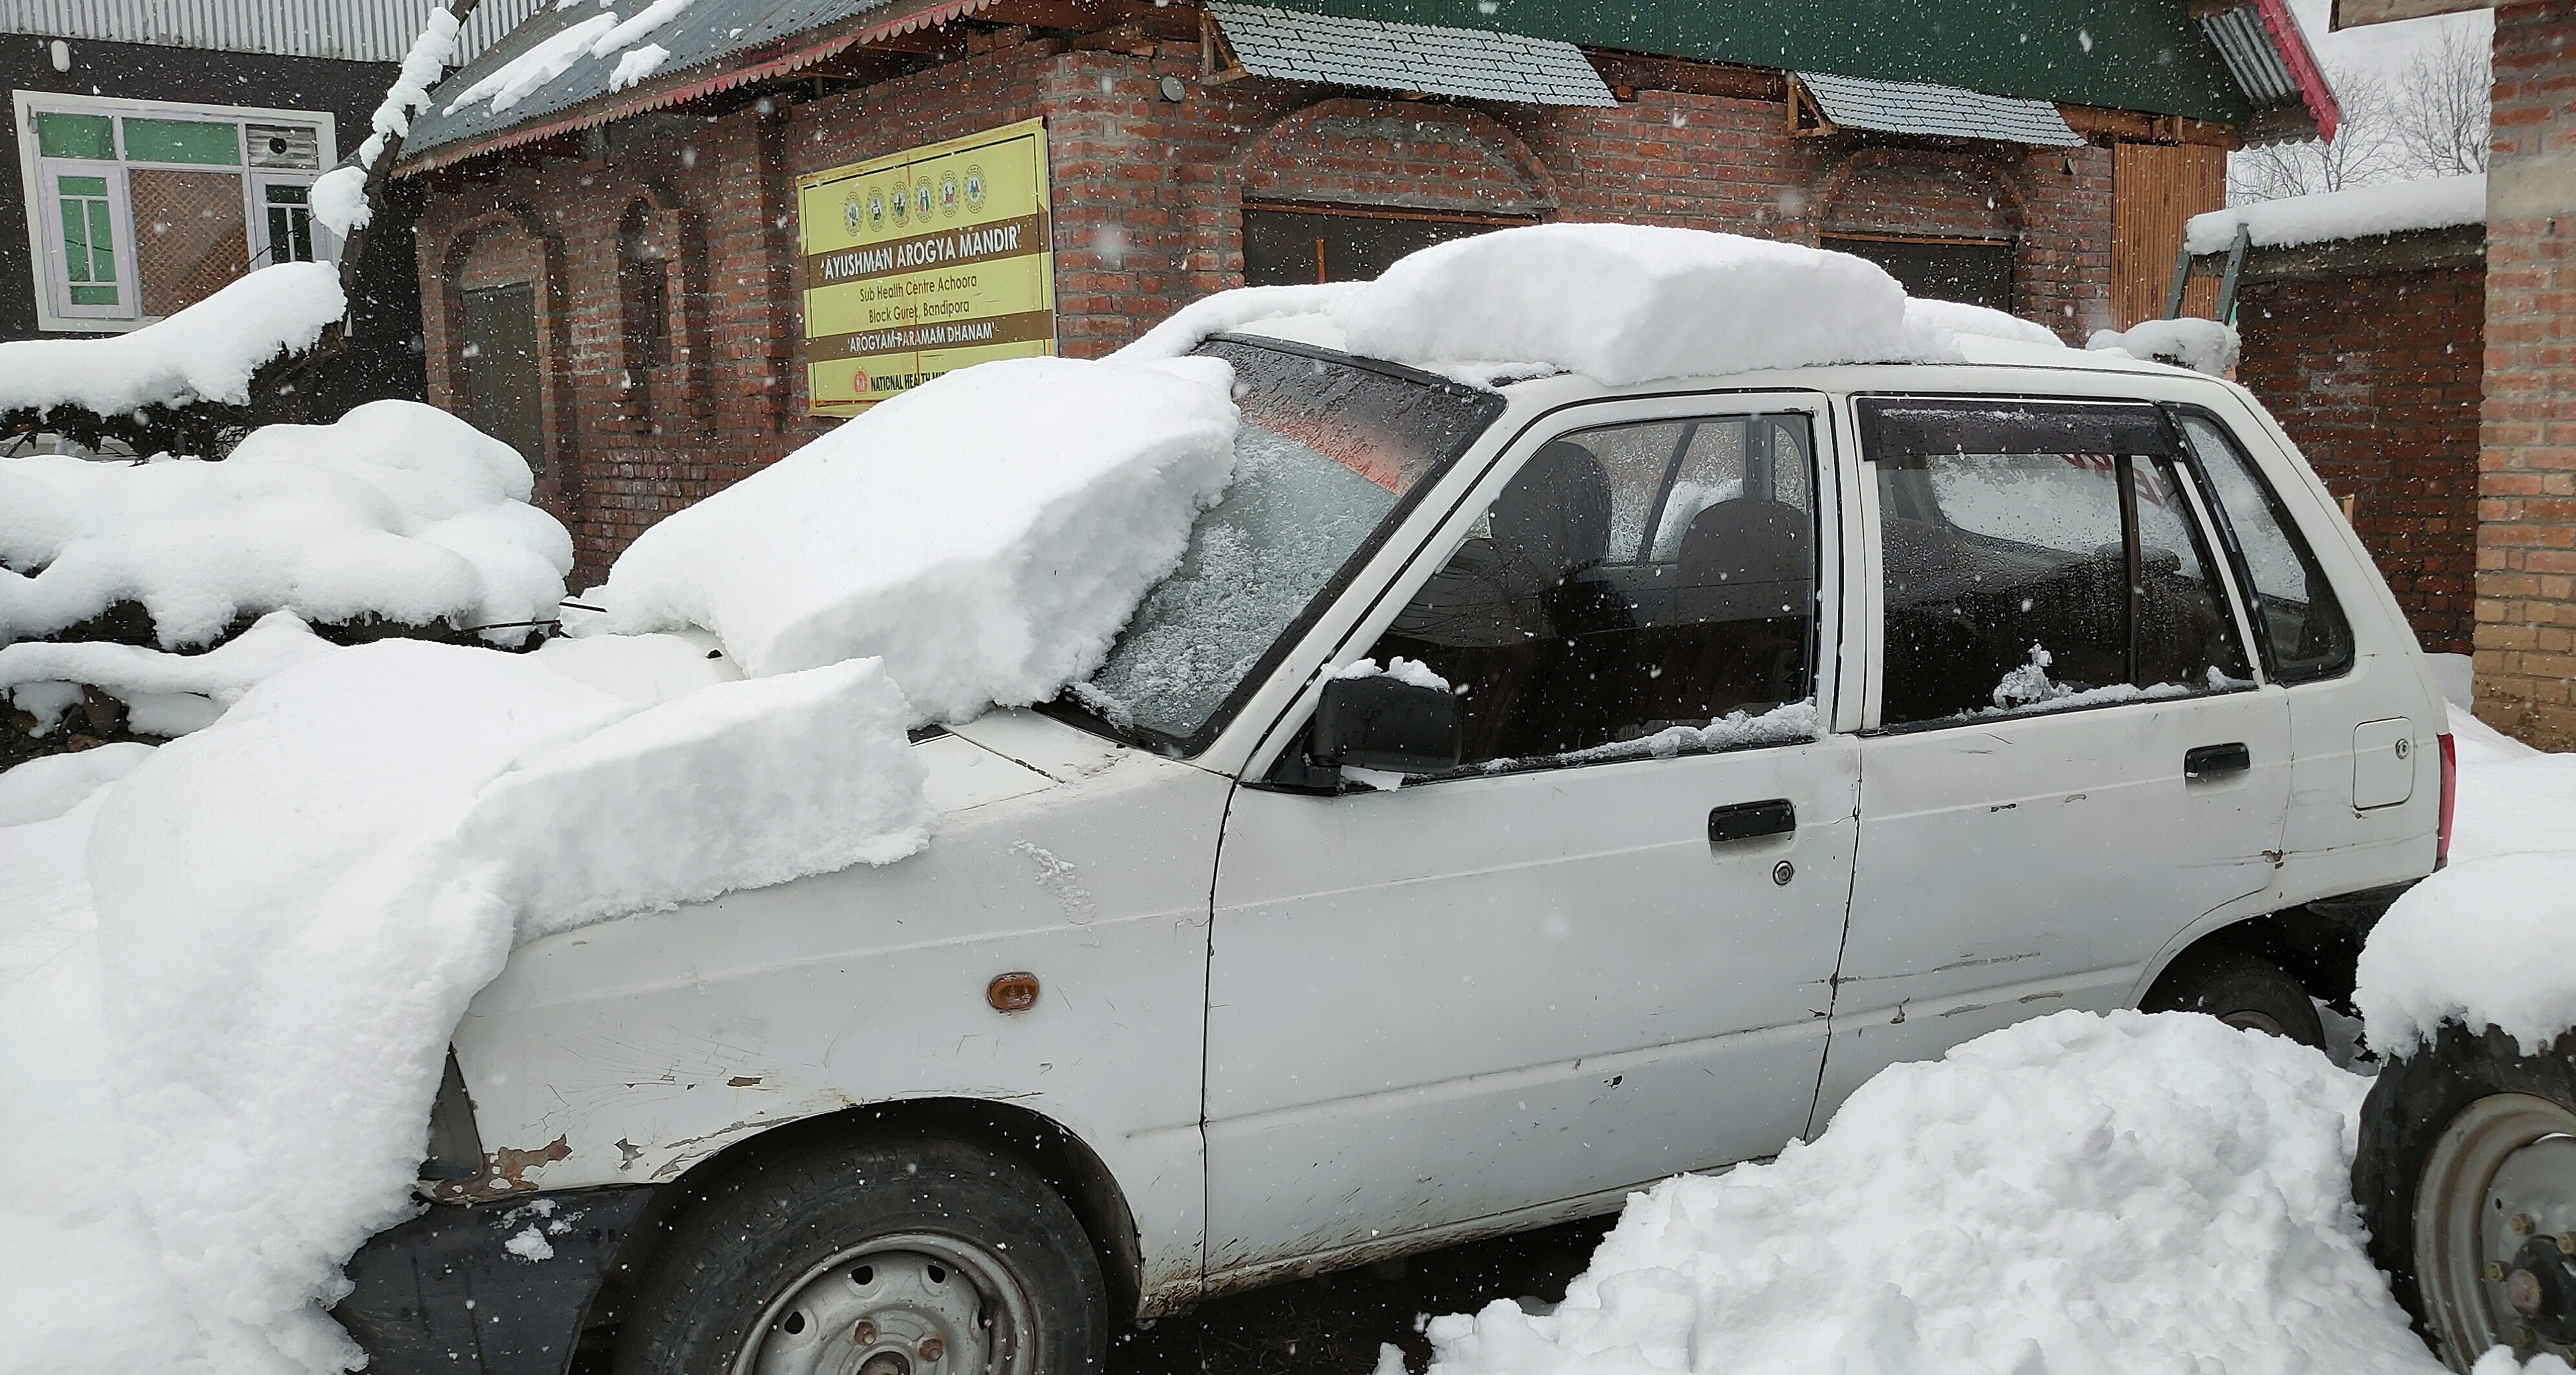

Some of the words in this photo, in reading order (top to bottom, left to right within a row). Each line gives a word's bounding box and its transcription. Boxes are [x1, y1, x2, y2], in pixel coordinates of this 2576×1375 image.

[896, 236, 956, 268] AROGYA
[860, 286, 875, 302] Sub
[877, 283, 904, 300] Health
[906, 279, 935, 296] Centre
[938, 275, 977, 292] Achoora
[869, 307, 892, 324] Block
[923, 300, 970, 317] Bandipora
[895, 326, 945, 347] PARAMAM
[871, 374, 904, 392] NATIONAL
